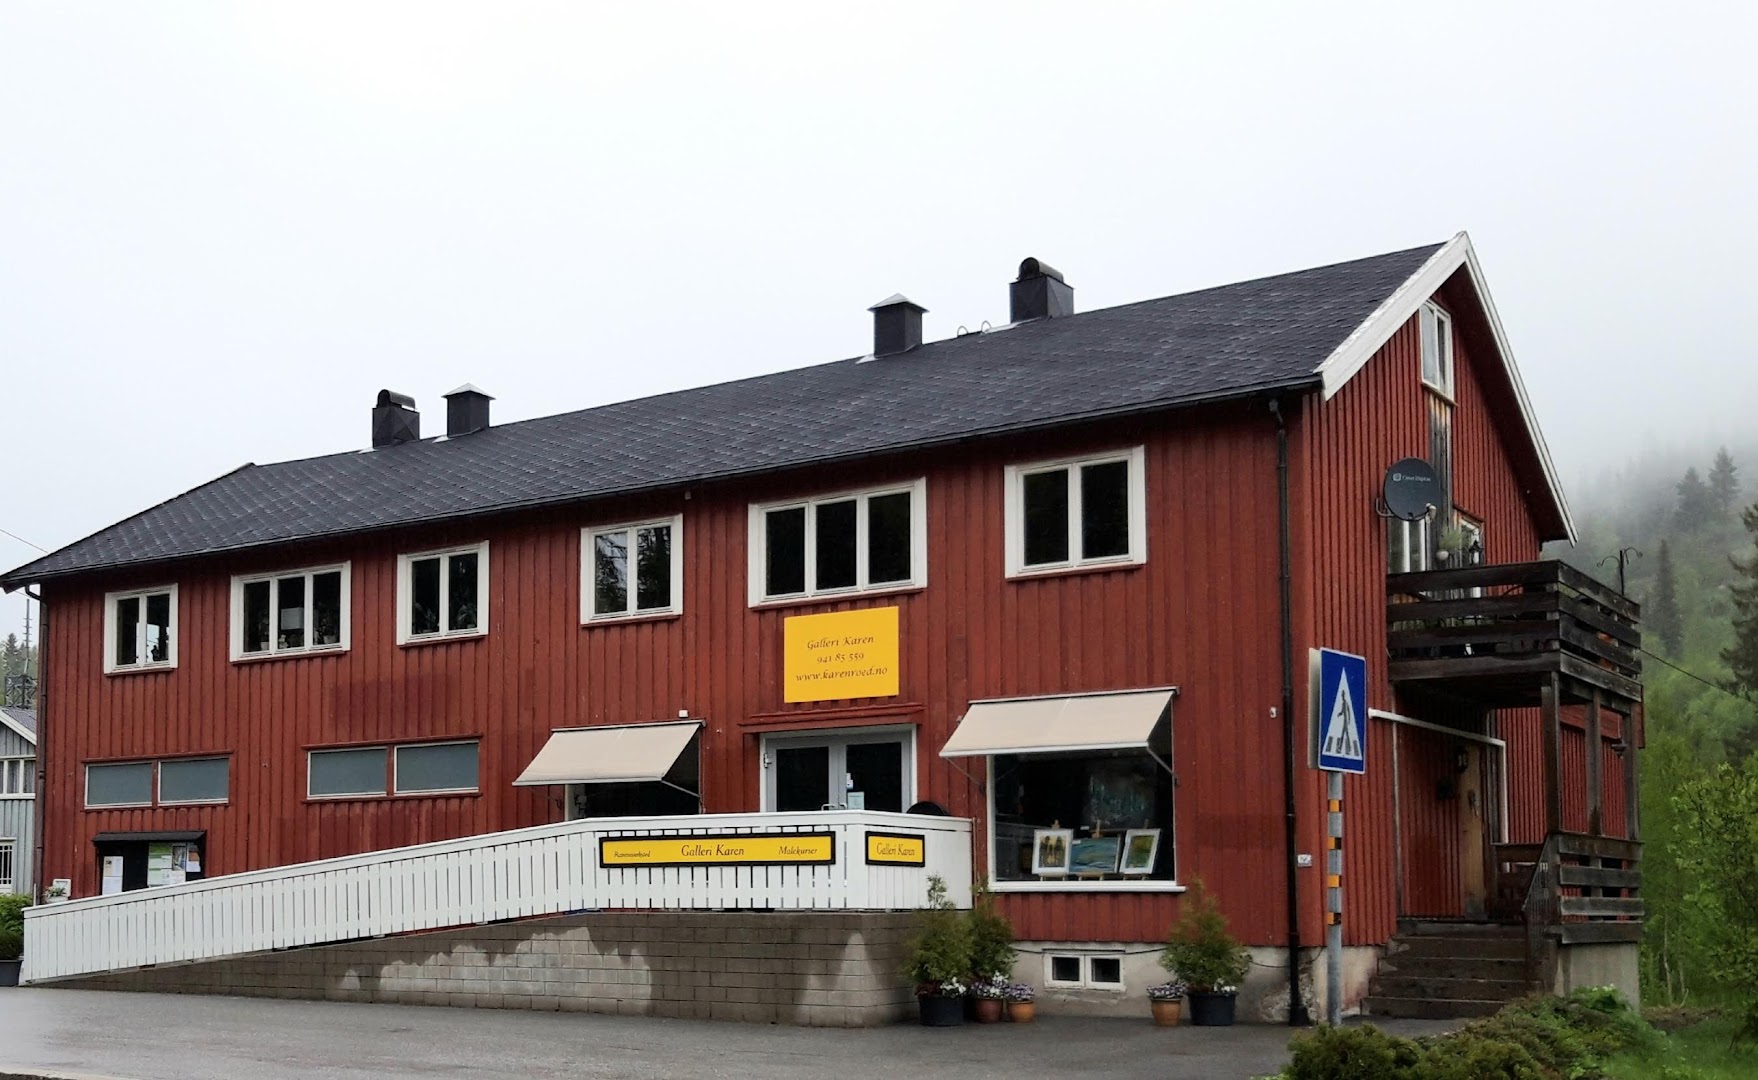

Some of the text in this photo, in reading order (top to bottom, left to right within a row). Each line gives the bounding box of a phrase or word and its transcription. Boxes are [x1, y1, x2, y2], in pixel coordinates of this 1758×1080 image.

[807, 636, 874, 650] Galleri Karen
[817, 653, 864, 663] 941 85 559
[795, 665, 888, 681] www.karenroed.no
[681, 843, 818, 857] Galleri Karen Malekurser
[876, 842, 915, 856] Galleri Karen
